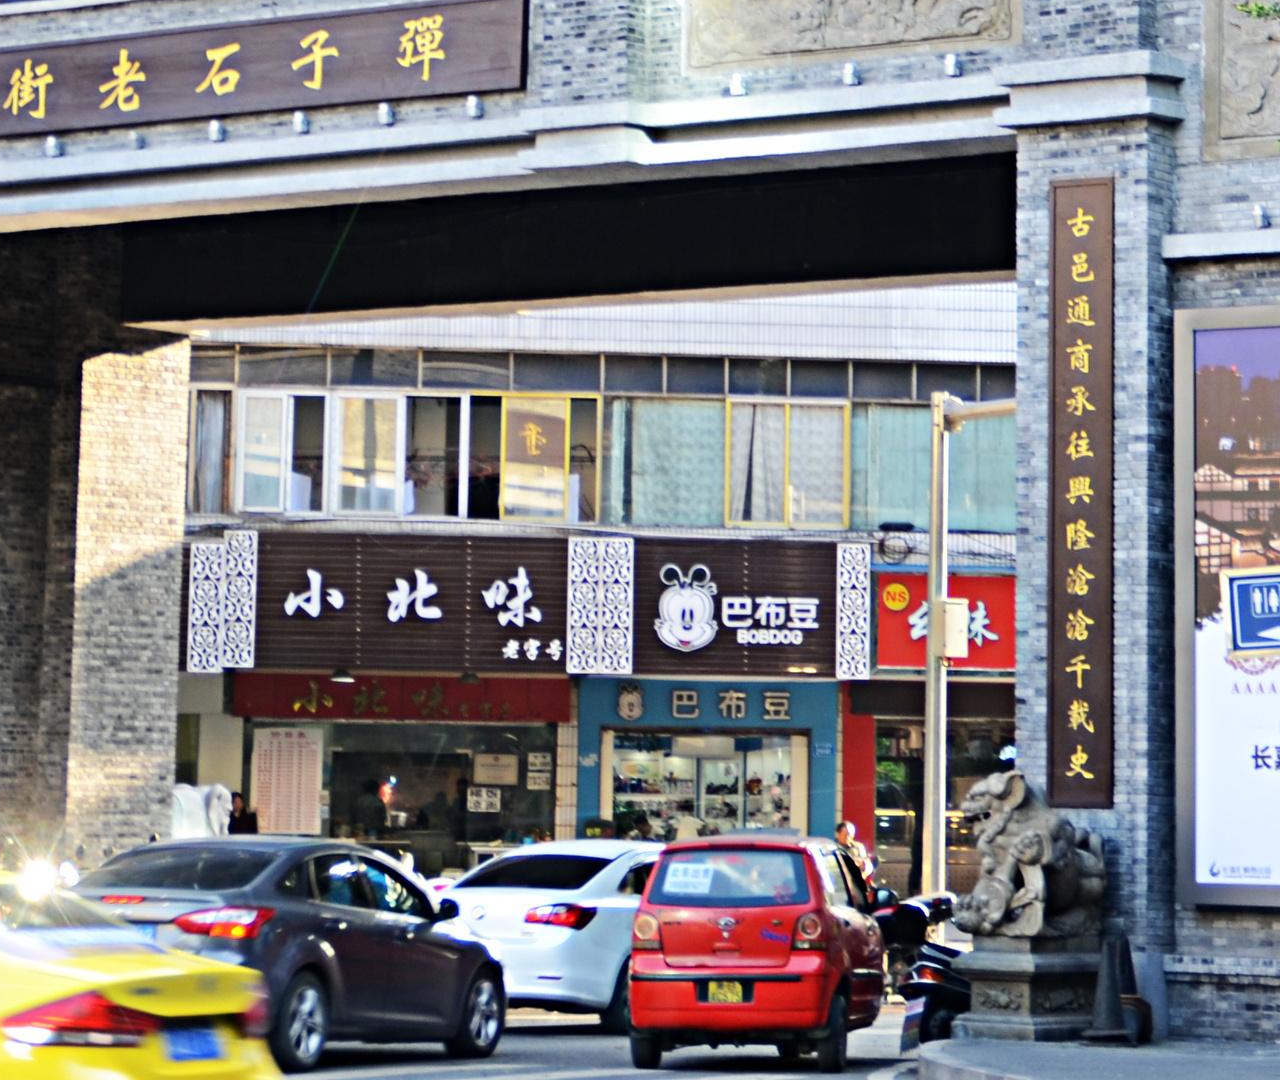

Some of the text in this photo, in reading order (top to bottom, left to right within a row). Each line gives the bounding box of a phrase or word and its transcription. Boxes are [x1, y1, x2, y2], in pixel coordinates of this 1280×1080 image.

[284, 566, 543, 628] 小北味
[721, 596, 820, 629] 巴布豆
[885, 590, 908, 604] NS
[736, 628, 804, 645] BOBDOG
[672, 688, 792, 721] 巴布豆
